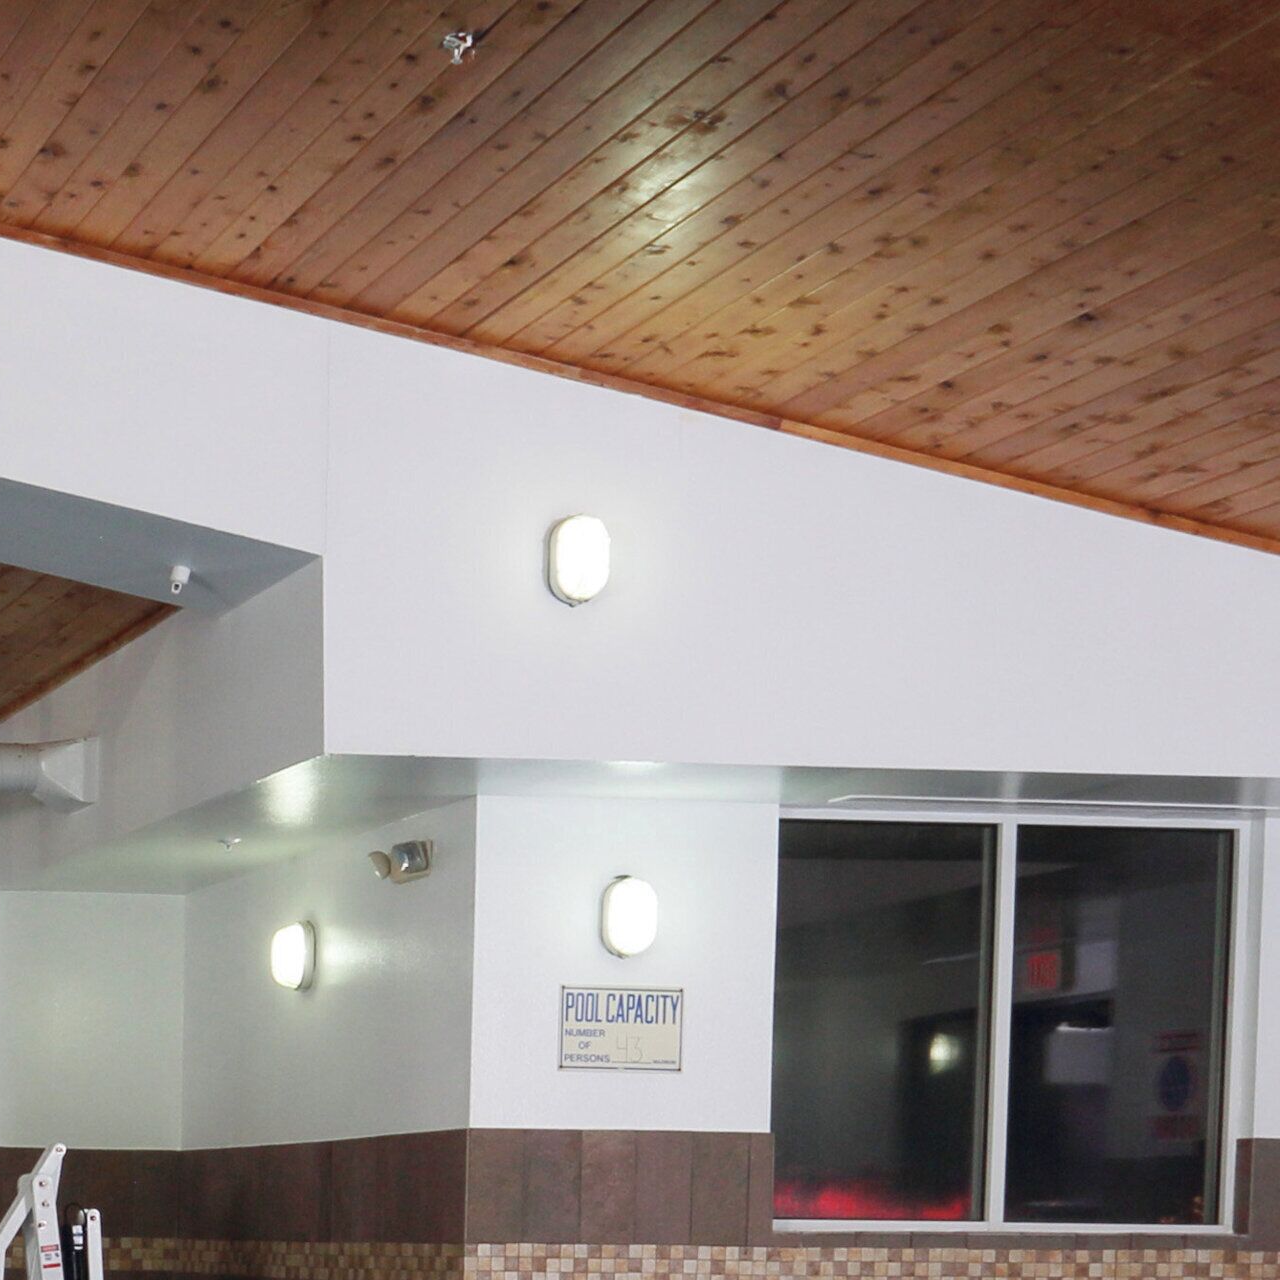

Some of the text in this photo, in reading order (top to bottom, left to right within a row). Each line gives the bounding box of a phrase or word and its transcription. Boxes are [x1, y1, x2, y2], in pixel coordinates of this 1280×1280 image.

[565, 992, 680, 1025] POOL CAPACITY
[564, 1028, 606, 1038] NUMBER
[578, 1041, 591, 1050] OF
[564, 1053, 611, 1063] PERSONS
